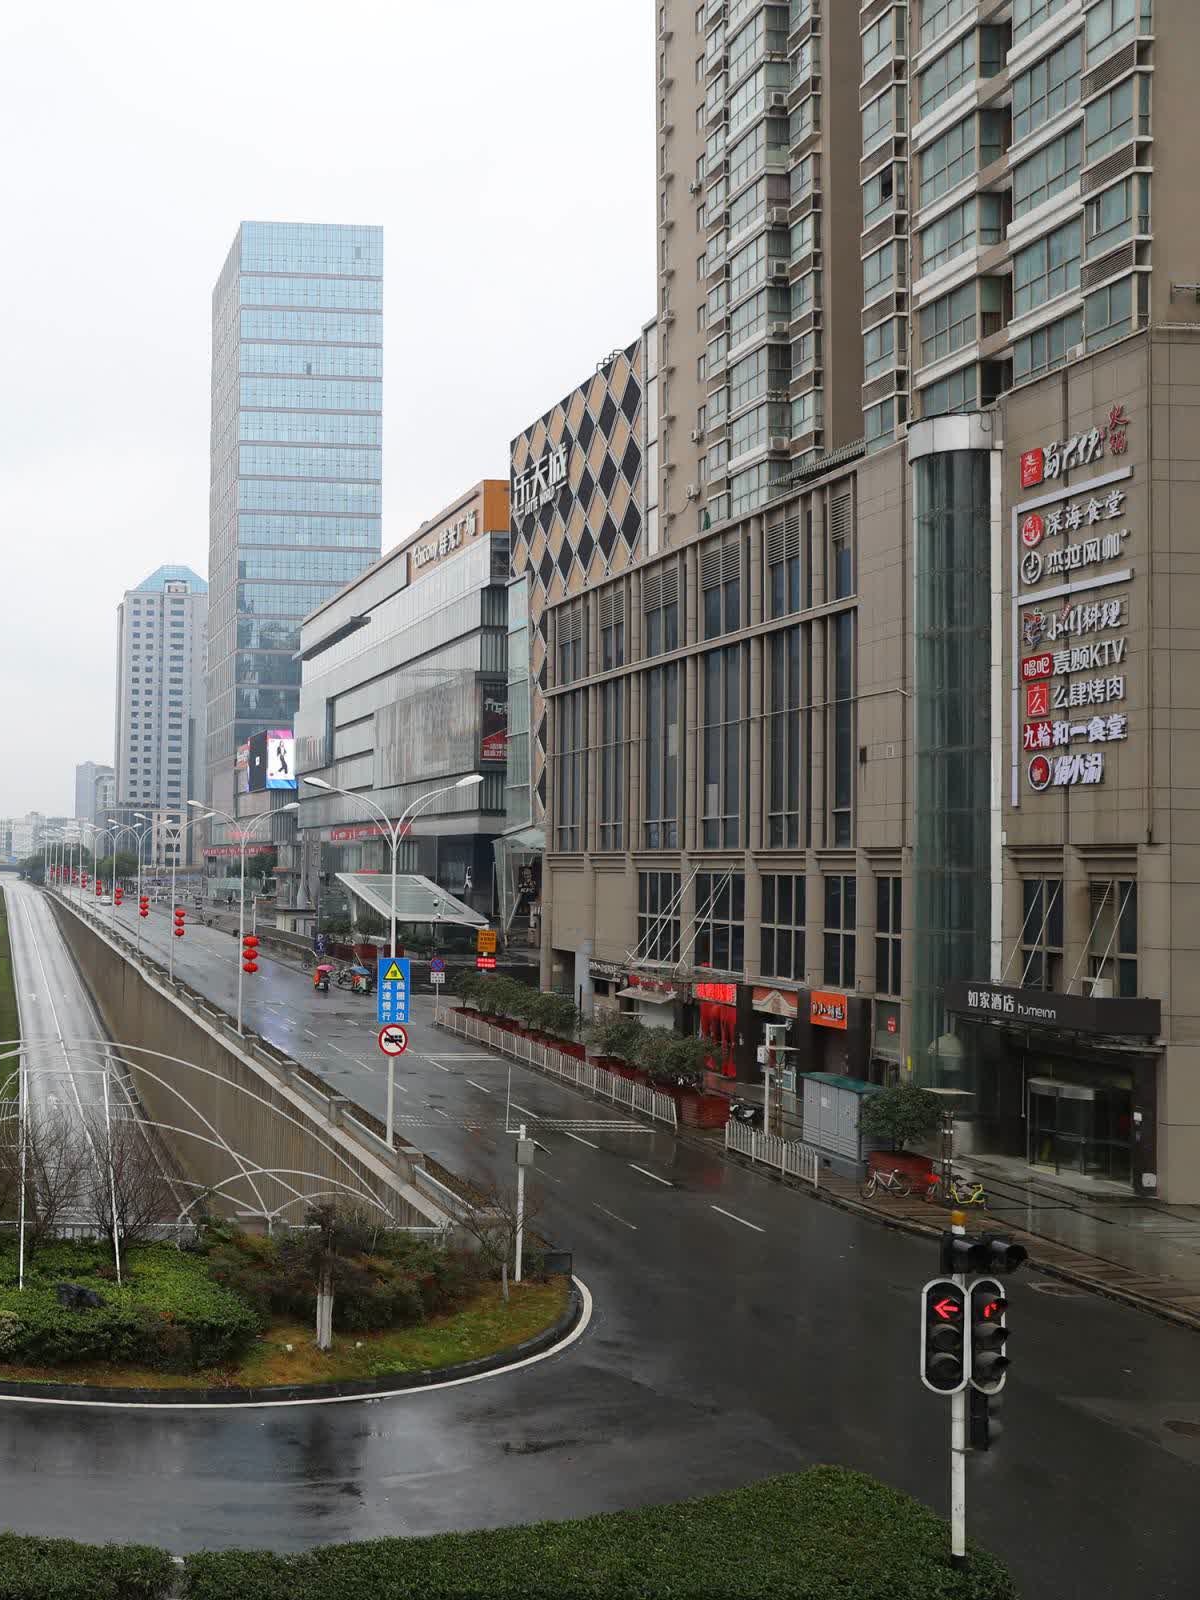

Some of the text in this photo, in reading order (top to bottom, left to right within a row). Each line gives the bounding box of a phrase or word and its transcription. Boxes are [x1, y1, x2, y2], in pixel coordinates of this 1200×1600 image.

[1047, 489, 1126, 536] 深海食堂
[1047, 532, 1121, 575] 杰拉网咖
[1047, 599, 1121, 640] 小川料理
[1023, 656, 1050, 677] 唱吧
[1054, 675, 1124, 708] 么肆烤肉
[1052, 713, 1127, 746] 和一食堂
[967, 990, 1015, 1013] 如家酒店
